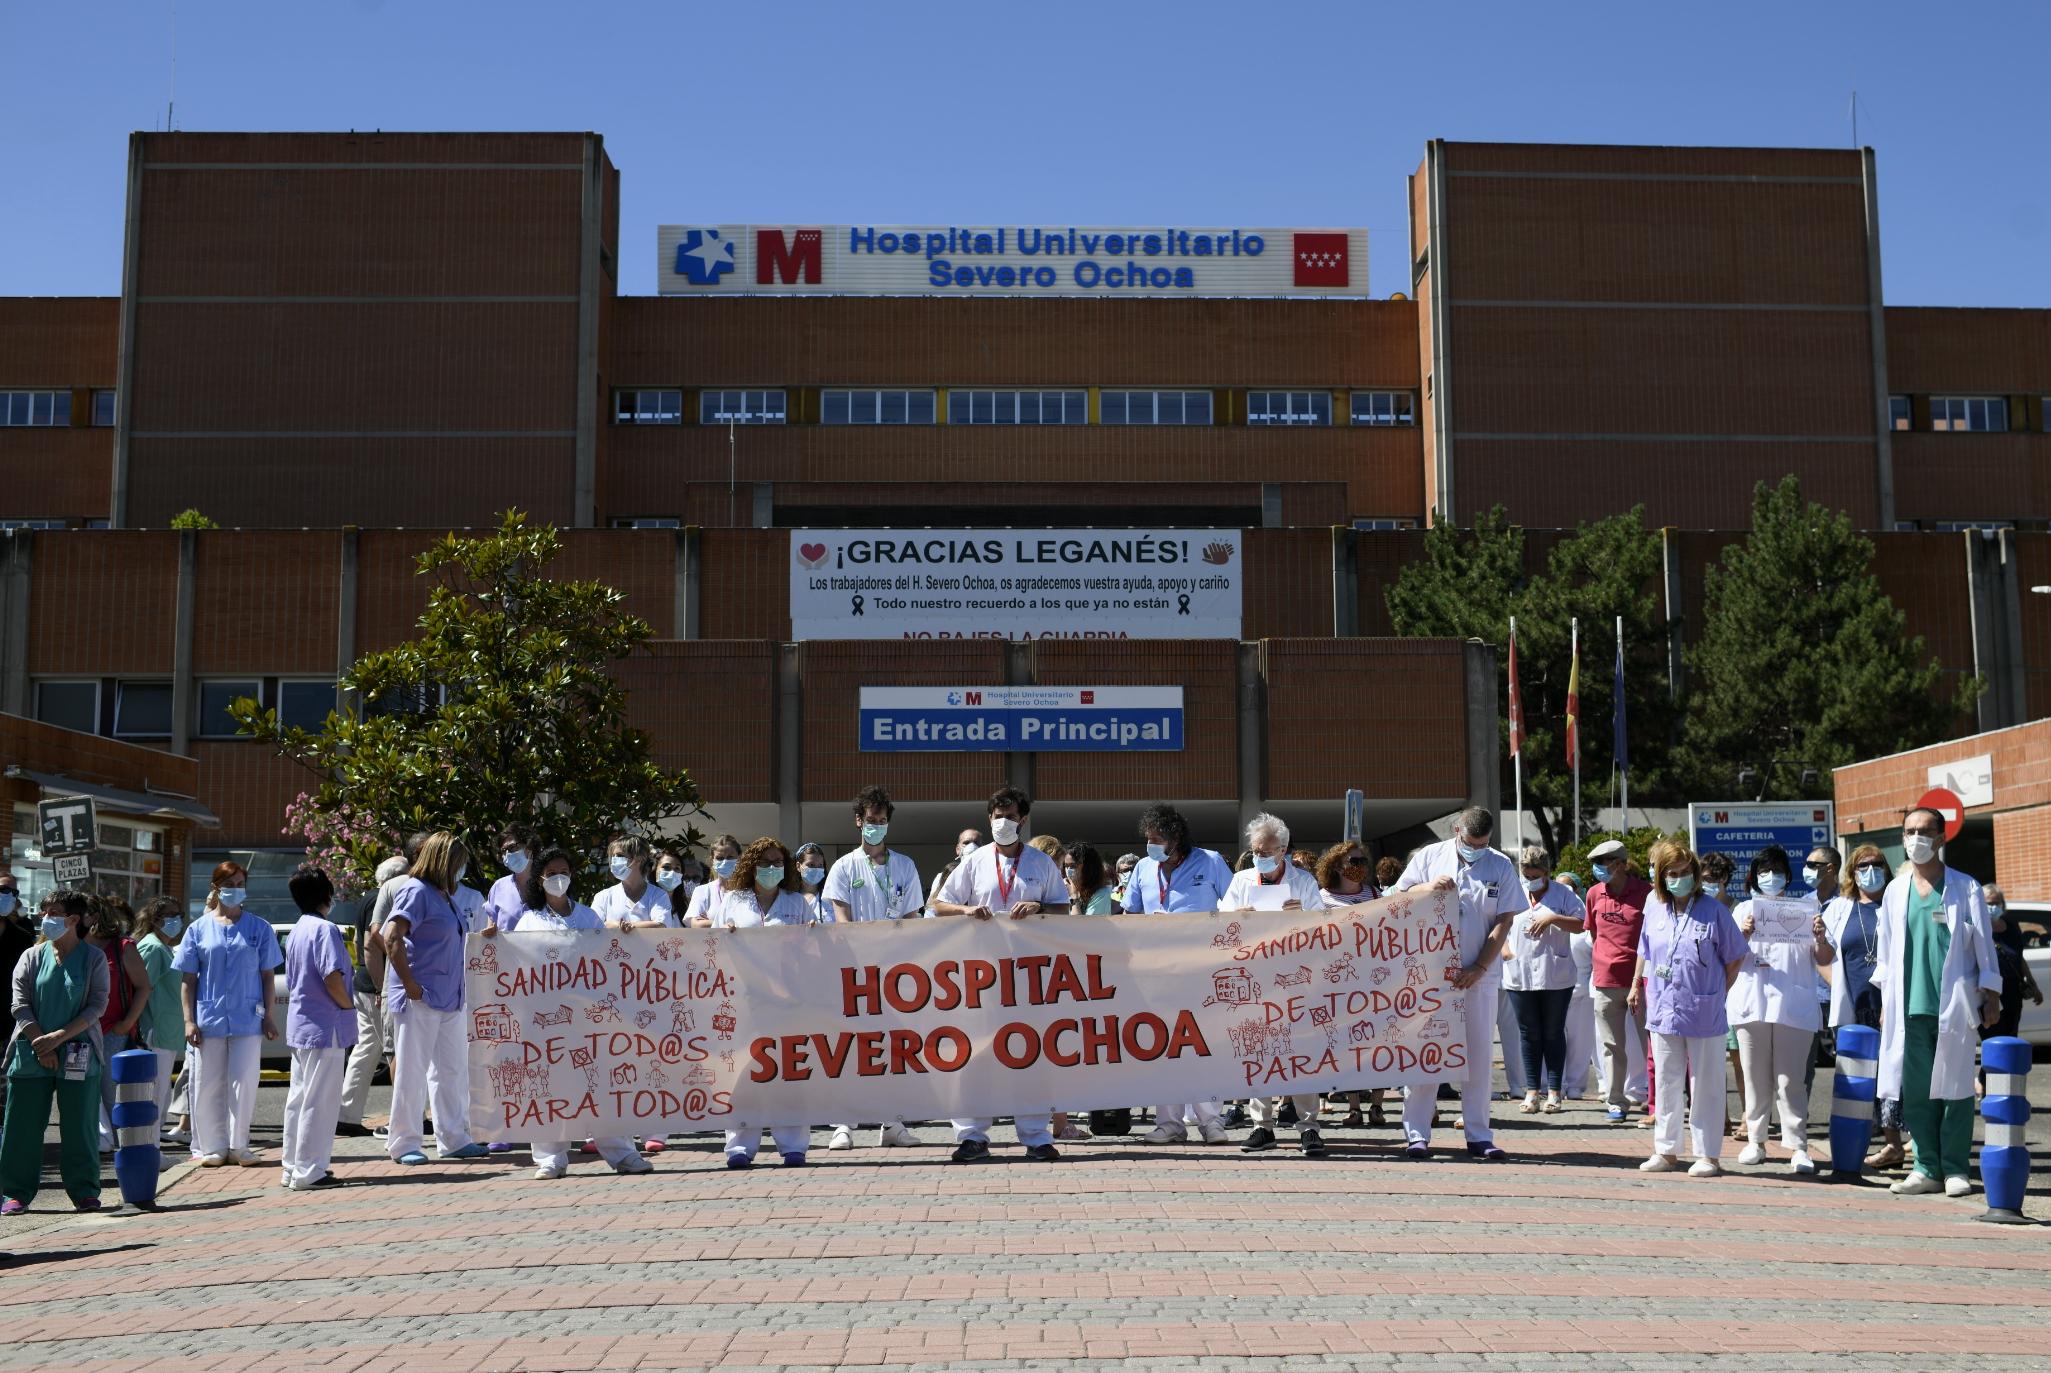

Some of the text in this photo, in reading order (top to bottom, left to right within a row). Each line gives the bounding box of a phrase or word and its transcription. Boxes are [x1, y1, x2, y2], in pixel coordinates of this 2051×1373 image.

[850, 227, 1265, 260] Hospital Universitario
[928, 259, 1194, 288] Severo Ochoa
[835, 534, 1190, 569] ¡GRACIAS LEGANÉS!
[810, 576, 1229, 593] Los trabajadores del H. Severo Ochoa, os agradecemos vuestra ayuda, apoyo y cariño
[874, 597, 1169, 612] Todo nuestro recuerdo a los que ya no están
[988, 691, 1019, 699] Hospital
[873, 717, 1170, 745] Entrada Principal
[1716, 832, 1775, 841] CAFETERIA
[58, 867, 87, 879] PLAZAS
[61, 857, 83, 868] CINCO
[1233, 923, 1343, 961] SANIDAD
[495, 956, 735, 1004] SANIDAD PÚBLICA:
[840, 953, 1116, 1017] HOSPITAL
[1264, 987, 1442, 1024] DE TOD@S
[521, 1032, 709, 1066] DE TOD@S
[749, 1010, 1211, 1083] SEVERO OCHOA
[1242, 1042, 1466, 1086] PARA TOD@S
[502, 1088, 733, 1128] PARA TOD@S
